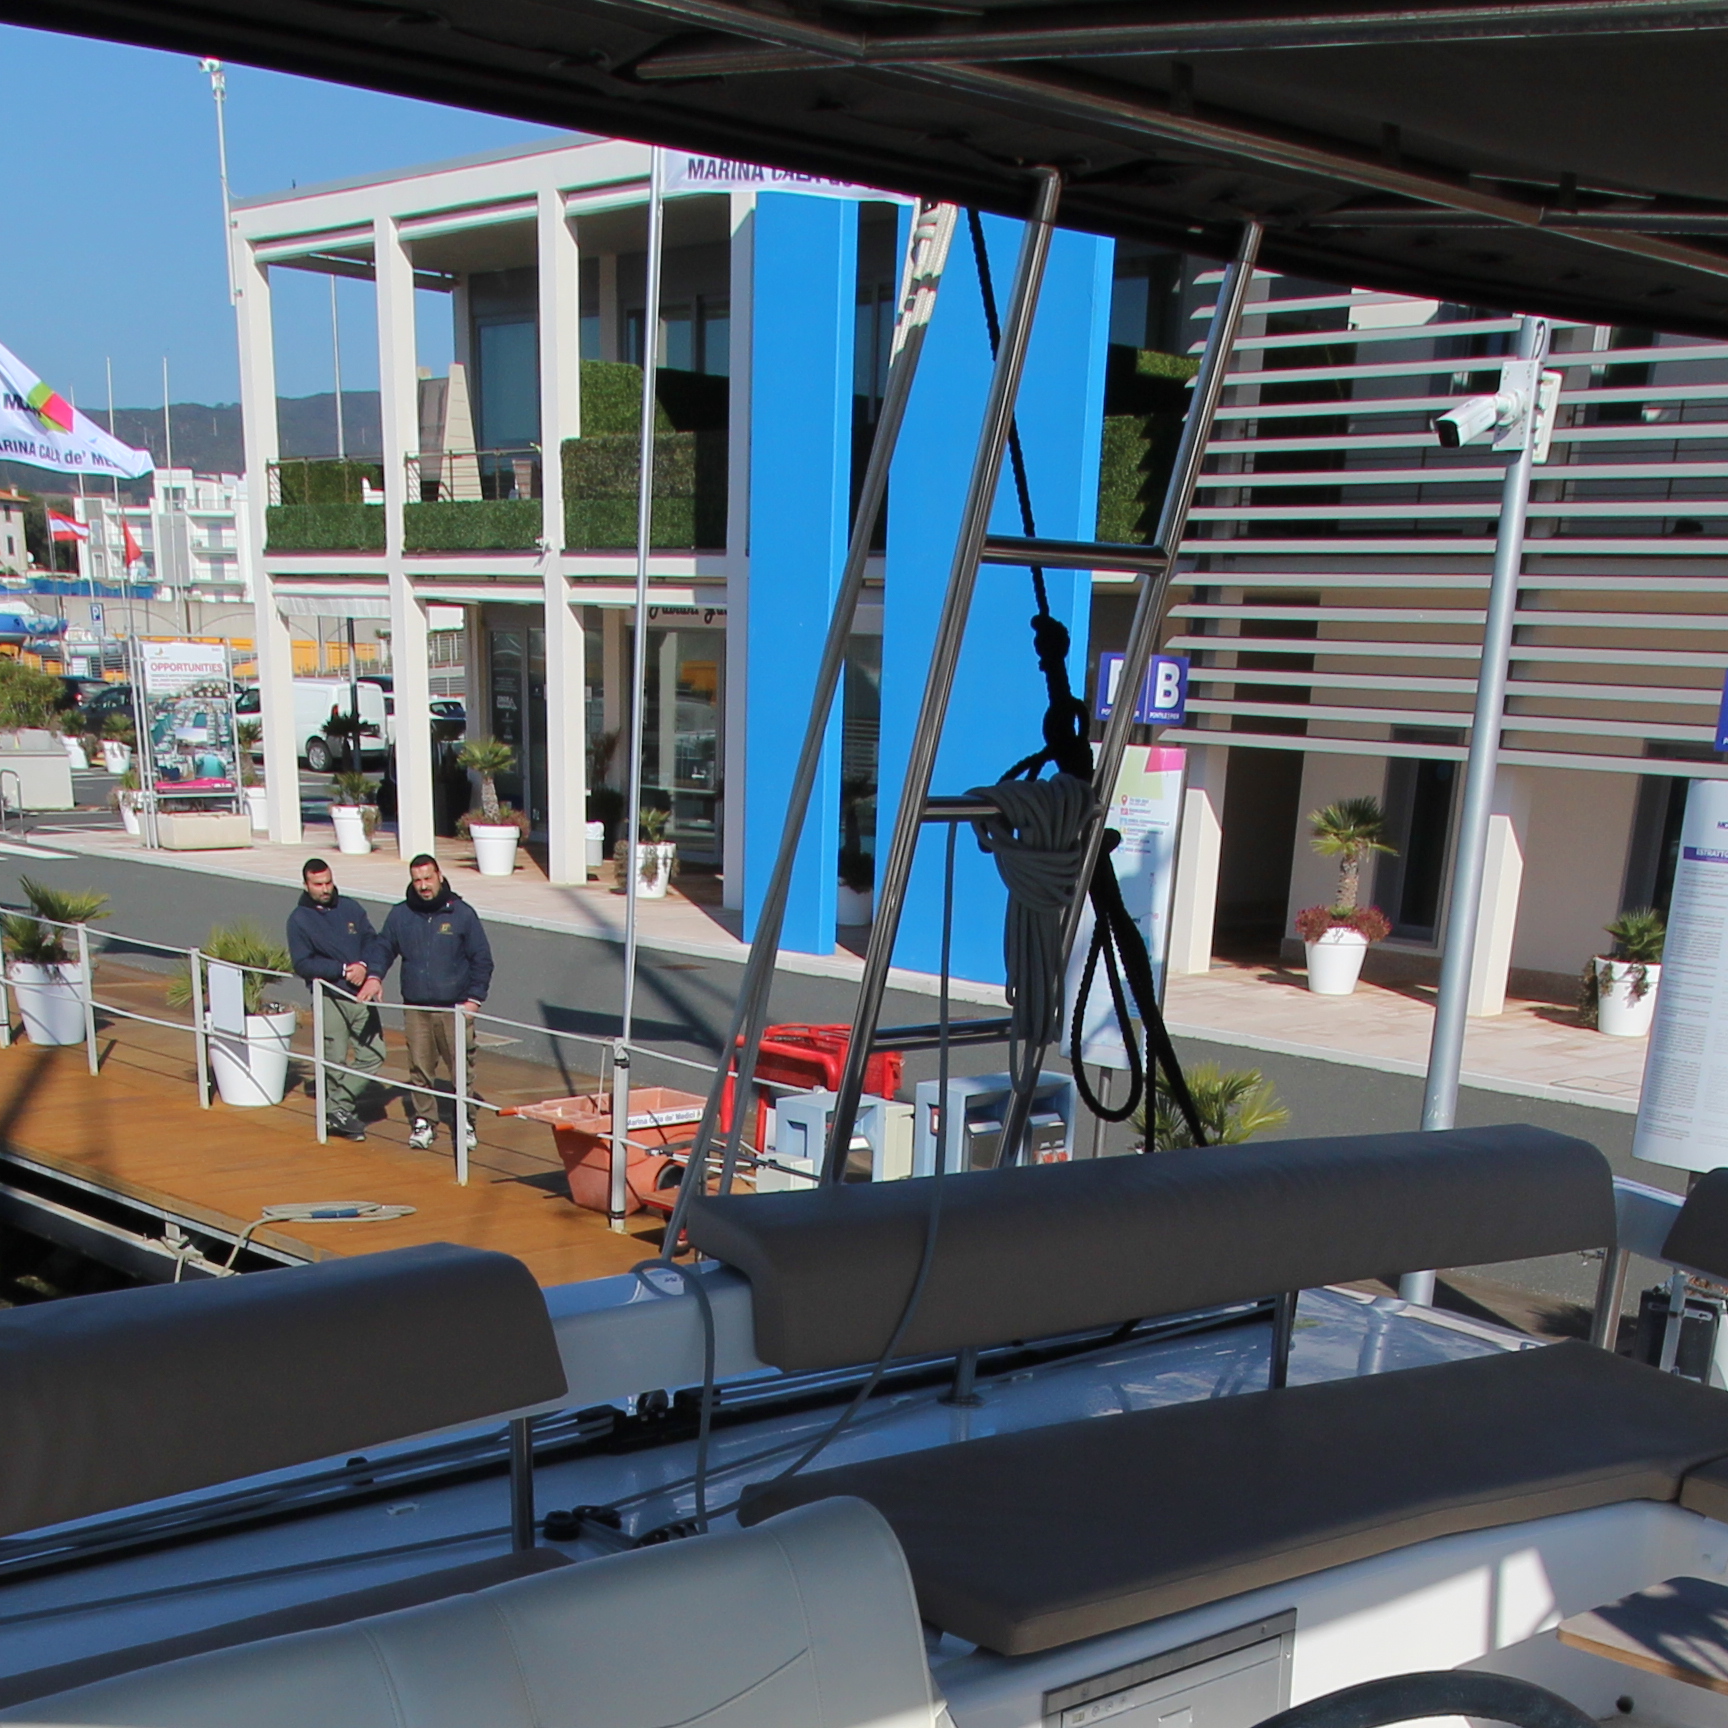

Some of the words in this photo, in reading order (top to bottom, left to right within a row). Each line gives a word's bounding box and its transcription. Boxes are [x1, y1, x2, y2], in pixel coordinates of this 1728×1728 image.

[687, 158, 764, 180] MARINA
[64, 450, 87, 466] de'
[150, 662, 224, 672] OPPORTUNITIES
[1154, 661, 1180, 709] B
